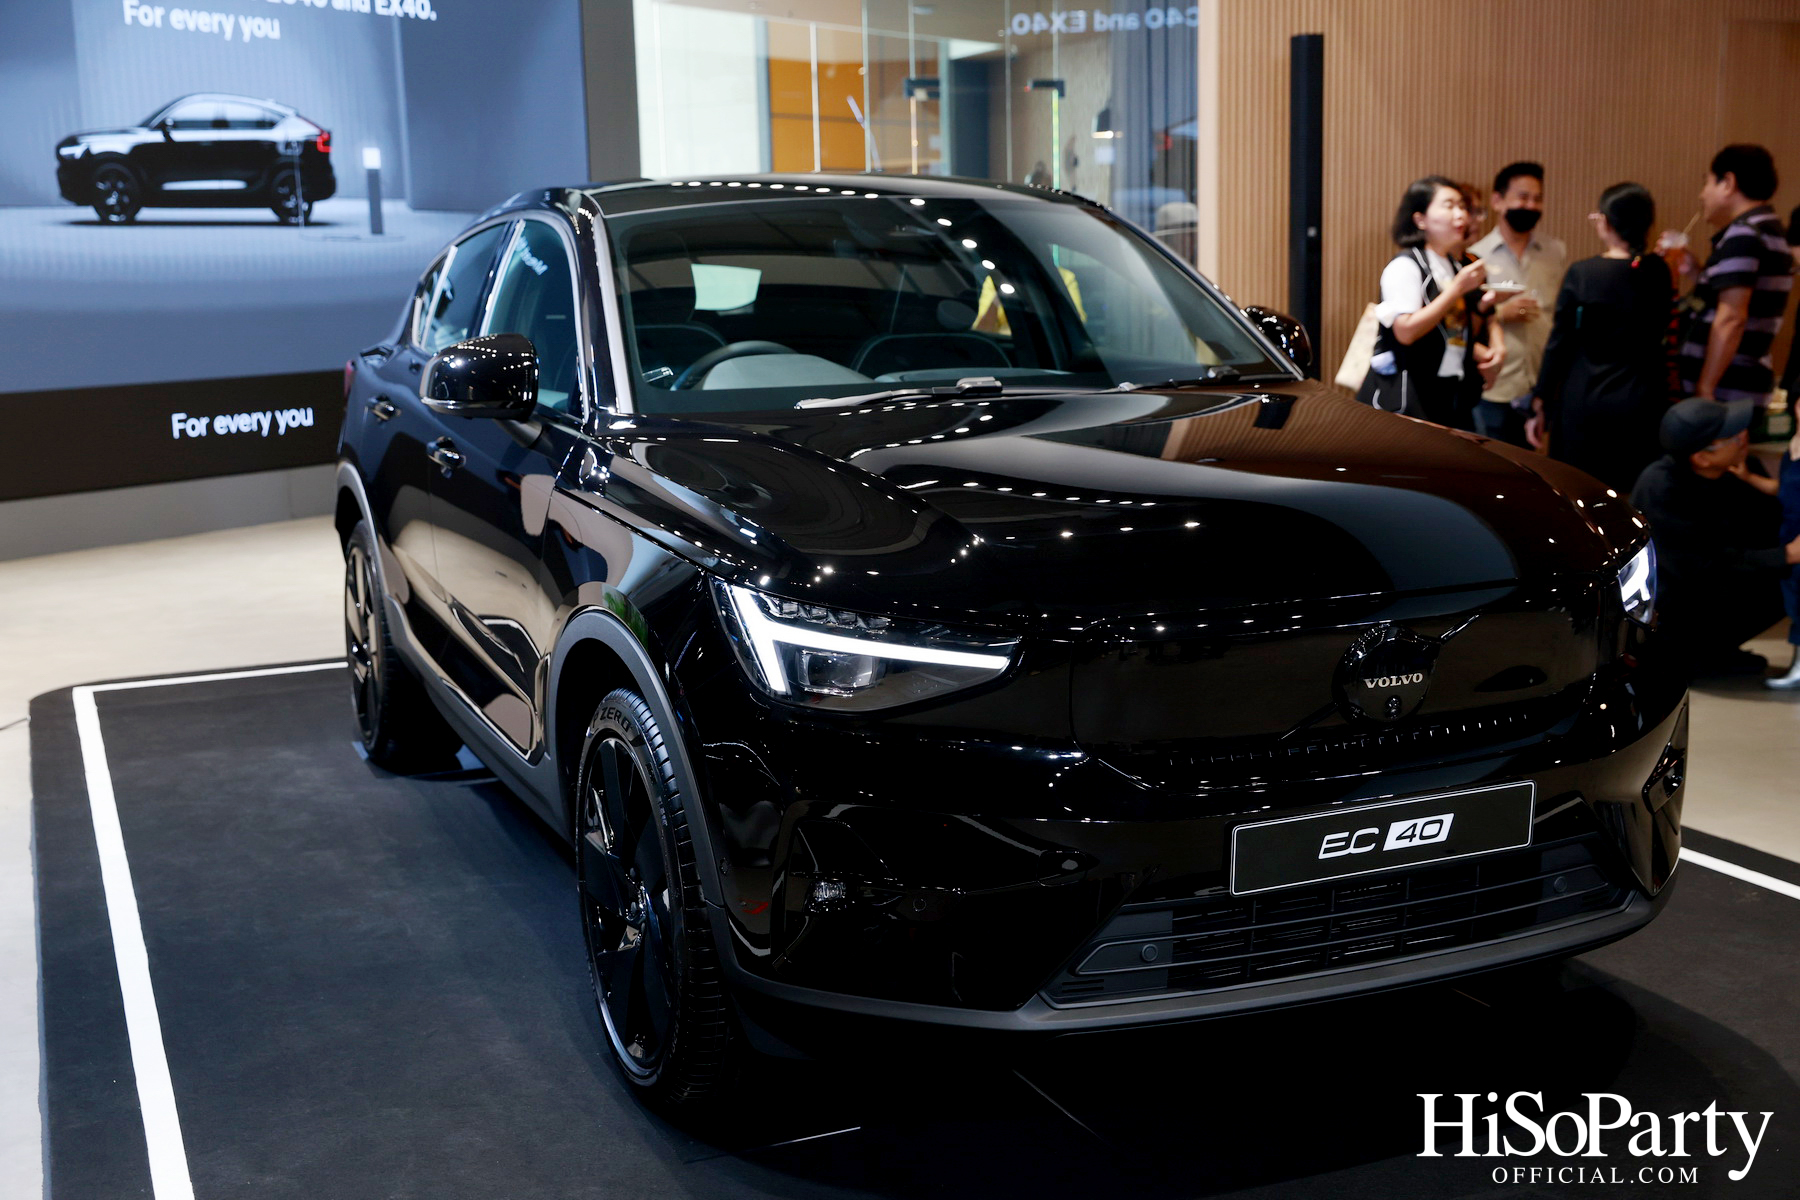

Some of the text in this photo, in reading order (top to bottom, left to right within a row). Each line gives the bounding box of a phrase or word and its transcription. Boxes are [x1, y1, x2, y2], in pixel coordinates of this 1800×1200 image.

[122, 0, 281, 43] For every you
[171, 407, 314, 440] For every you
[1363, 672, 1424, 689] VOLVO
[600, 706, 632, 733] ZERO
[1318, 817, 1446, 859] EC 40
